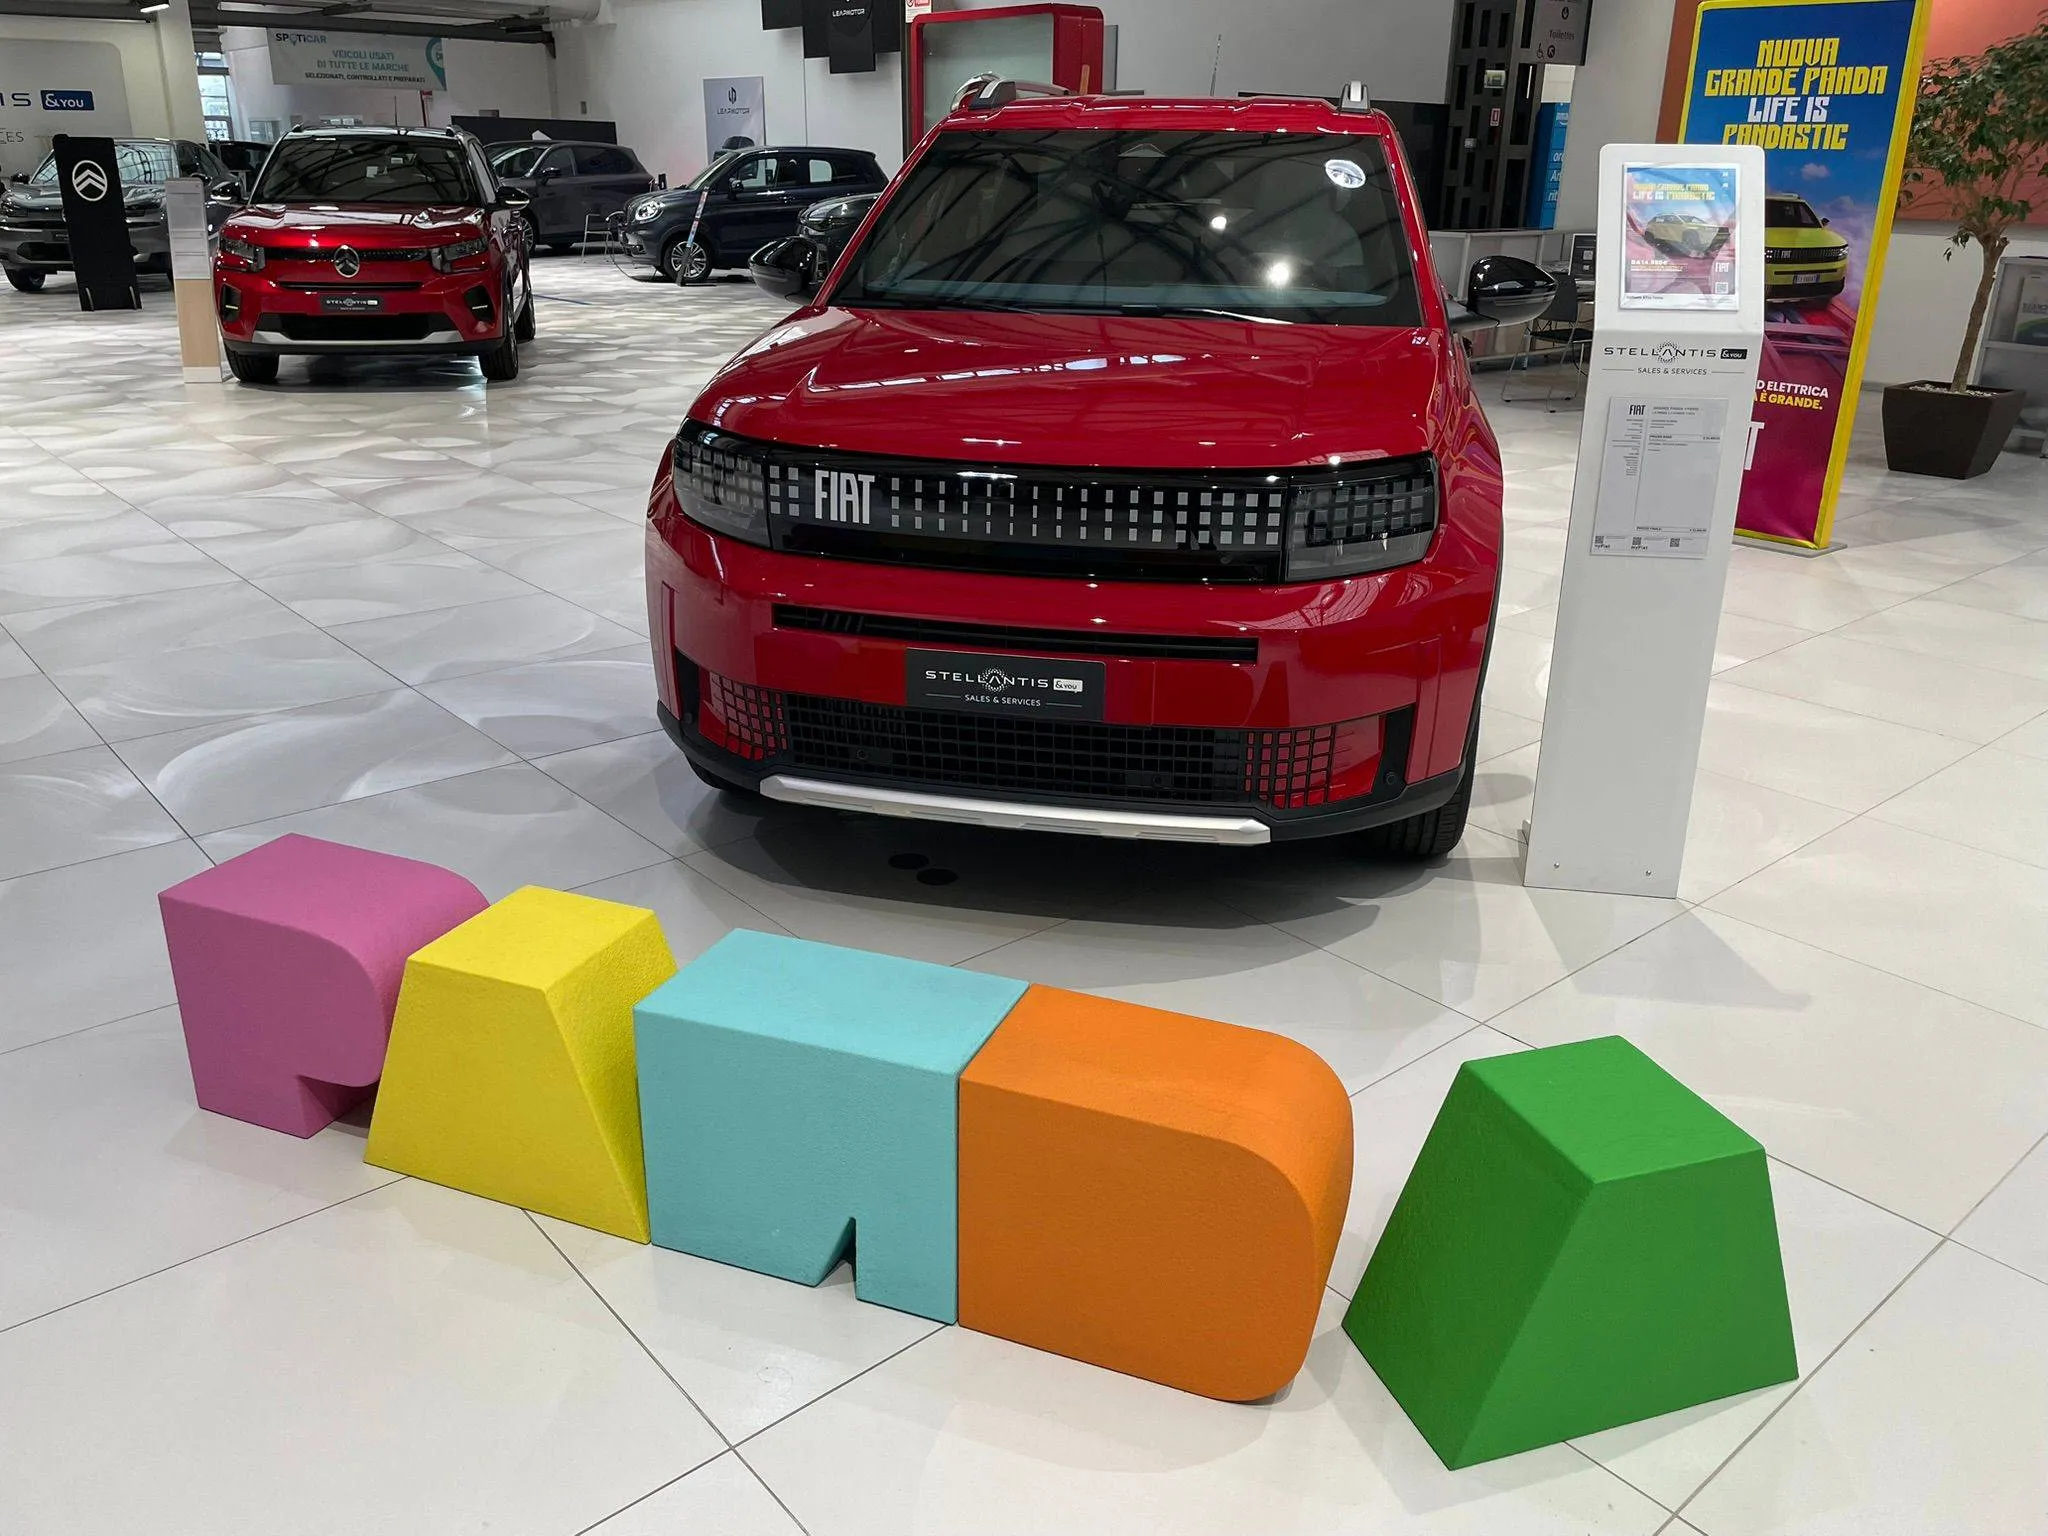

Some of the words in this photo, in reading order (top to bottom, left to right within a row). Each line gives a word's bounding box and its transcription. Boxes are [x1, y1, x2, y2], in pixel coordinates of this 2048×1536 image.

[276, 33, 328, 45] SPOTICAR
[332, 50, 367, 59] VEICOLI
[370, 51, 395, 60] USATI
[1757, 38, 1839, 67] NUOVA
[317, 60, 327, 69] DI
[329, 60, 357, 70] TUTTE
[359, 62, 370, 71] LE
[371, 62, 409, 72] MARCHE
[1705, 68, 1799, 96] GRANDE
[1802, 66, 1888, 95] PANDA
[45, 93, 84, 108] &YOU
[1747, 97, 1800, 123] LIFE
[1804, 97, 1830, 123] IS
[1722, 123, 1849, 150] PANDASTIC
[1604, 346, 1717, 358] STELLANTIS
[1637, 367, 1661, 375] SALES
[1671, 368, 1707, 376] SERVICES
[1767, 380, 1829, 399] ELETTRICA
[1760, 389, 1767, 403] È
[1768, 393, 1824, 411] GRANDE.
[1629, 404, 1646, 415] FIAT
[815, 469, 875, 525] FIAT
[925, 669, 1049, 689] STELLANTIS
[1055, 681, 1078, 691] &YOU
[964, 694, 991, 704] SALES
[993, 696, 1000, 704] &
[1001, 697, 1041, 708] SERVICES
